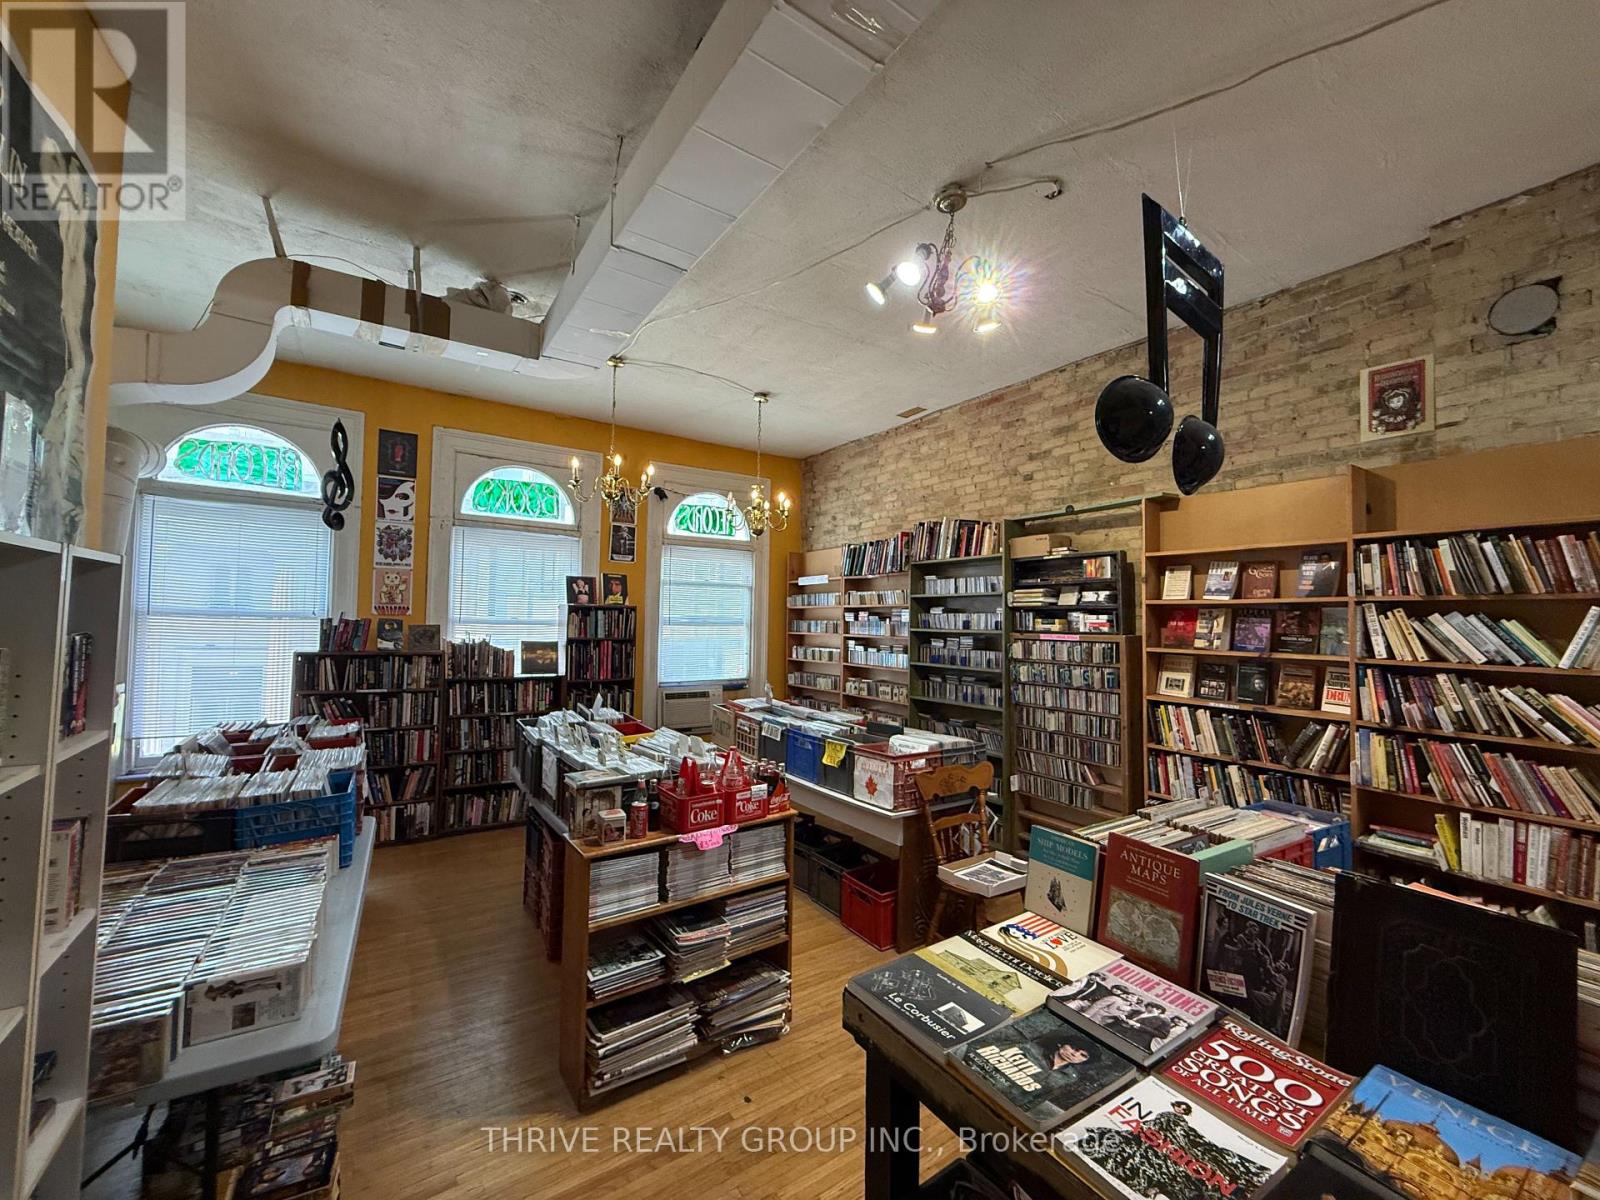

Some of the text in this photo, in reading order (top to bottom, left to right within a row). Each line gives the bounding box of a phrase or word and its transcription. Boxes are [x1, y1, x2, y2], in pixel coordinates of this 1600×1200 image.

[690, 808, 718, 824] Coke
[737, 800, 760, 813] Coke
[1055, 842, 1088, 860] MODELS
[1119, 850, 1182, 879] ANTIQUE
[1130, 864, 1167, 885] MAPS
[1217, 888, 1294, 923] FROM JULES VERNE
[1227, 900, 1282, 927] TO STAR TREK
[1106, 963, 1210, 1017] ROLLING STONES
[888, 992, 956, 1041] Le Corbusier
[976, 1045, 1042, 1092] RICHARDS
[1000, 1046, 1042, 1076] KEITH
[1198, 1039, 1324, 1107] 500
[1171, 1065, 1193, 1079] OF
[1191, 1078, 1222, 1099] ALL
[1226, 1098, 1270, 1125] TIME
[1178, 1057, 1307, 1130] SONGS
[1190, 1049, 1315, 1118] GREATEST
[1120, 1097, 1153, 1121] IN
[1388, 1073, 1544, 1158] VENICE
[1107, 1105, 1239, 1198] FASHION
